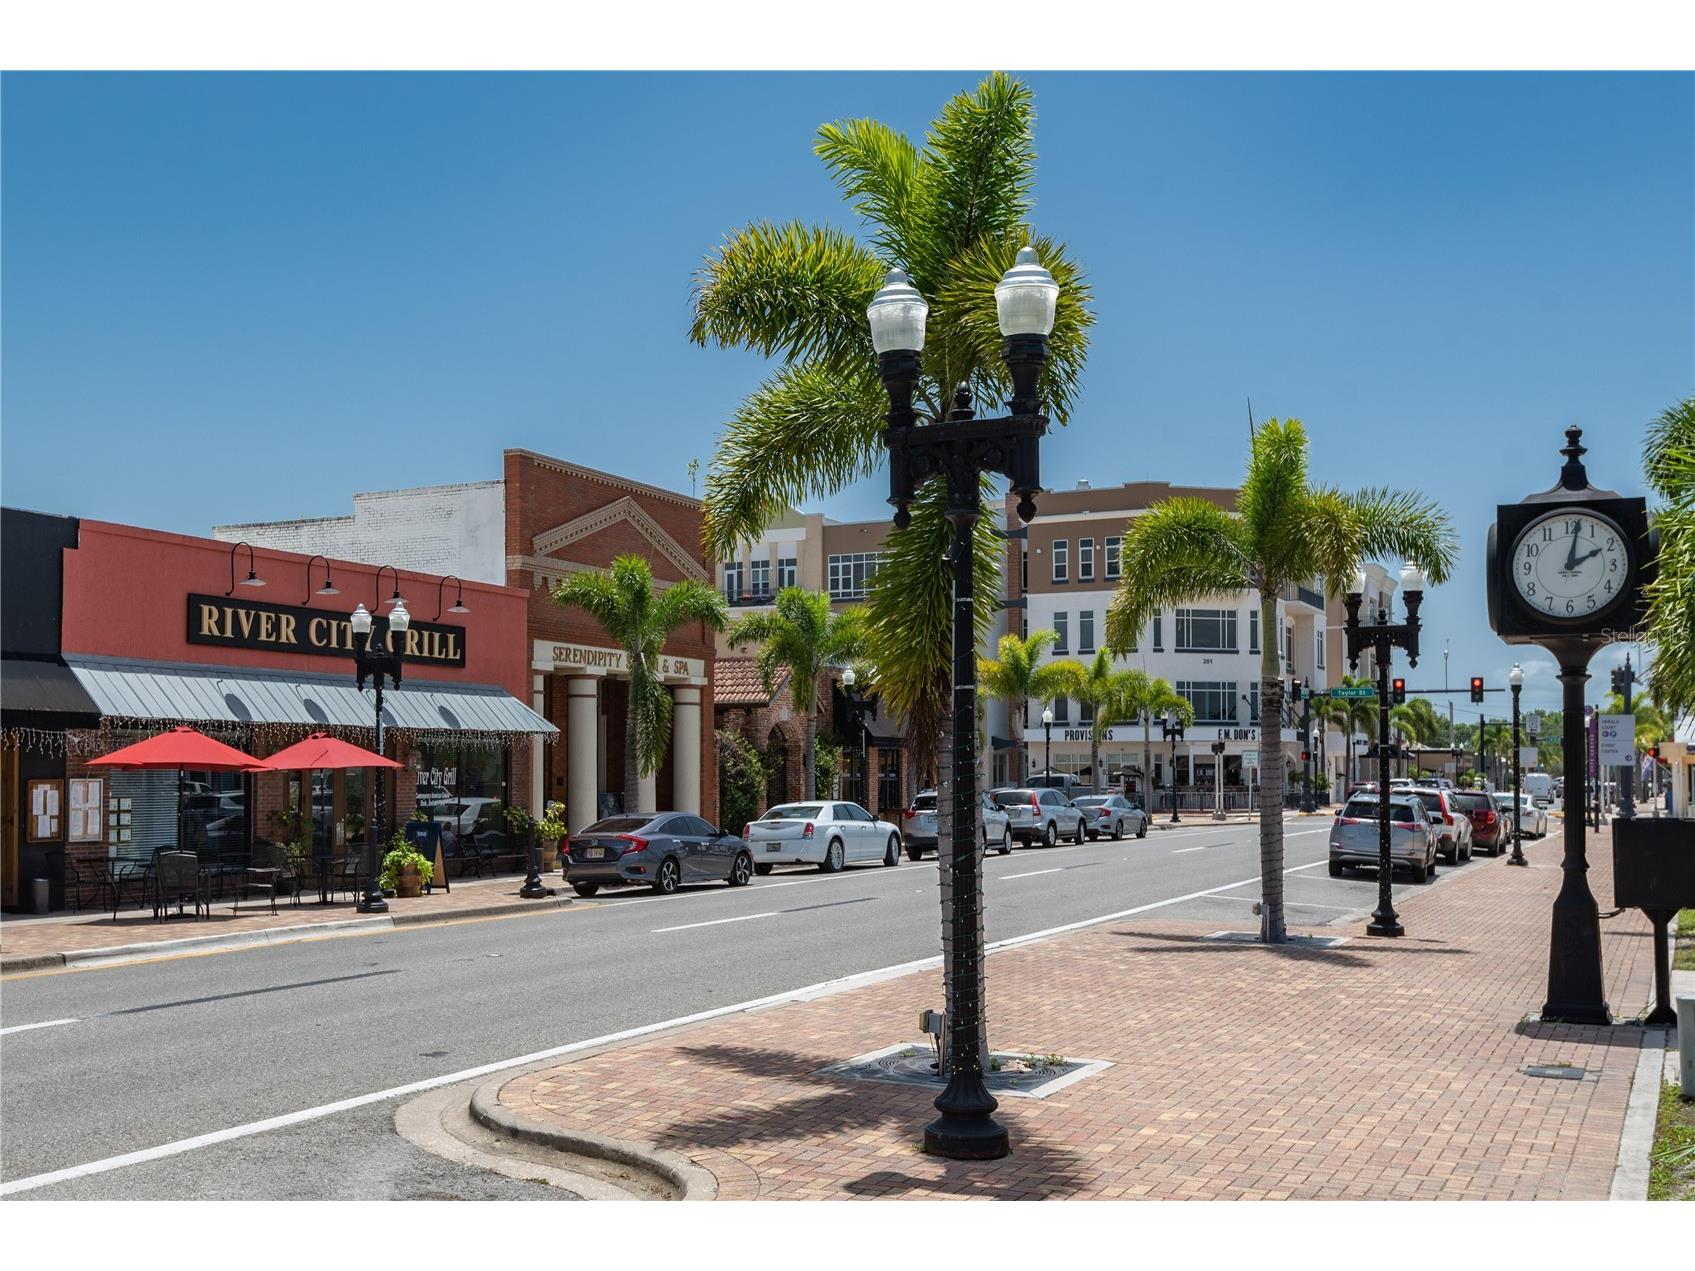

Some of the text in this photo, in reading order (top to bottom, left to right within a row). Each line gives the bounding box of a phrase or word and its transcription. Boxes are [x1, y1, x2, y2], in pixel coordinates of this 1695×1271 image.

[1543, 528, 1552, 541] 11
[1565, 520, 1578, 535] 12
[1590, 524, 1595, 539] 1
[1526, 543, 1539, 557] 10
[1607, 537, 1615, 552] 2
[1523, 561, 1531, 576] 9
[1609, 558, 1617, 572] 3
[1527, 582, 1536, 596] 8
[1604, 579, 1613, 593] 4
[1545, 596, 1553, 611] 7
[1566, 600, 1574, 614] 6
[1587, 594, 1596, 609] 5
[199, 603, 298, 644] RIVER
[552, 645, 622, 669] SERENDIPITY
[662, 658, 670, 674] &
[673, 660, 690, 676] SPA
[1234, 729, 1256, 741] DON'S
[430, 767, 443, 789] City
[443, 767, 457, 785] Grill
